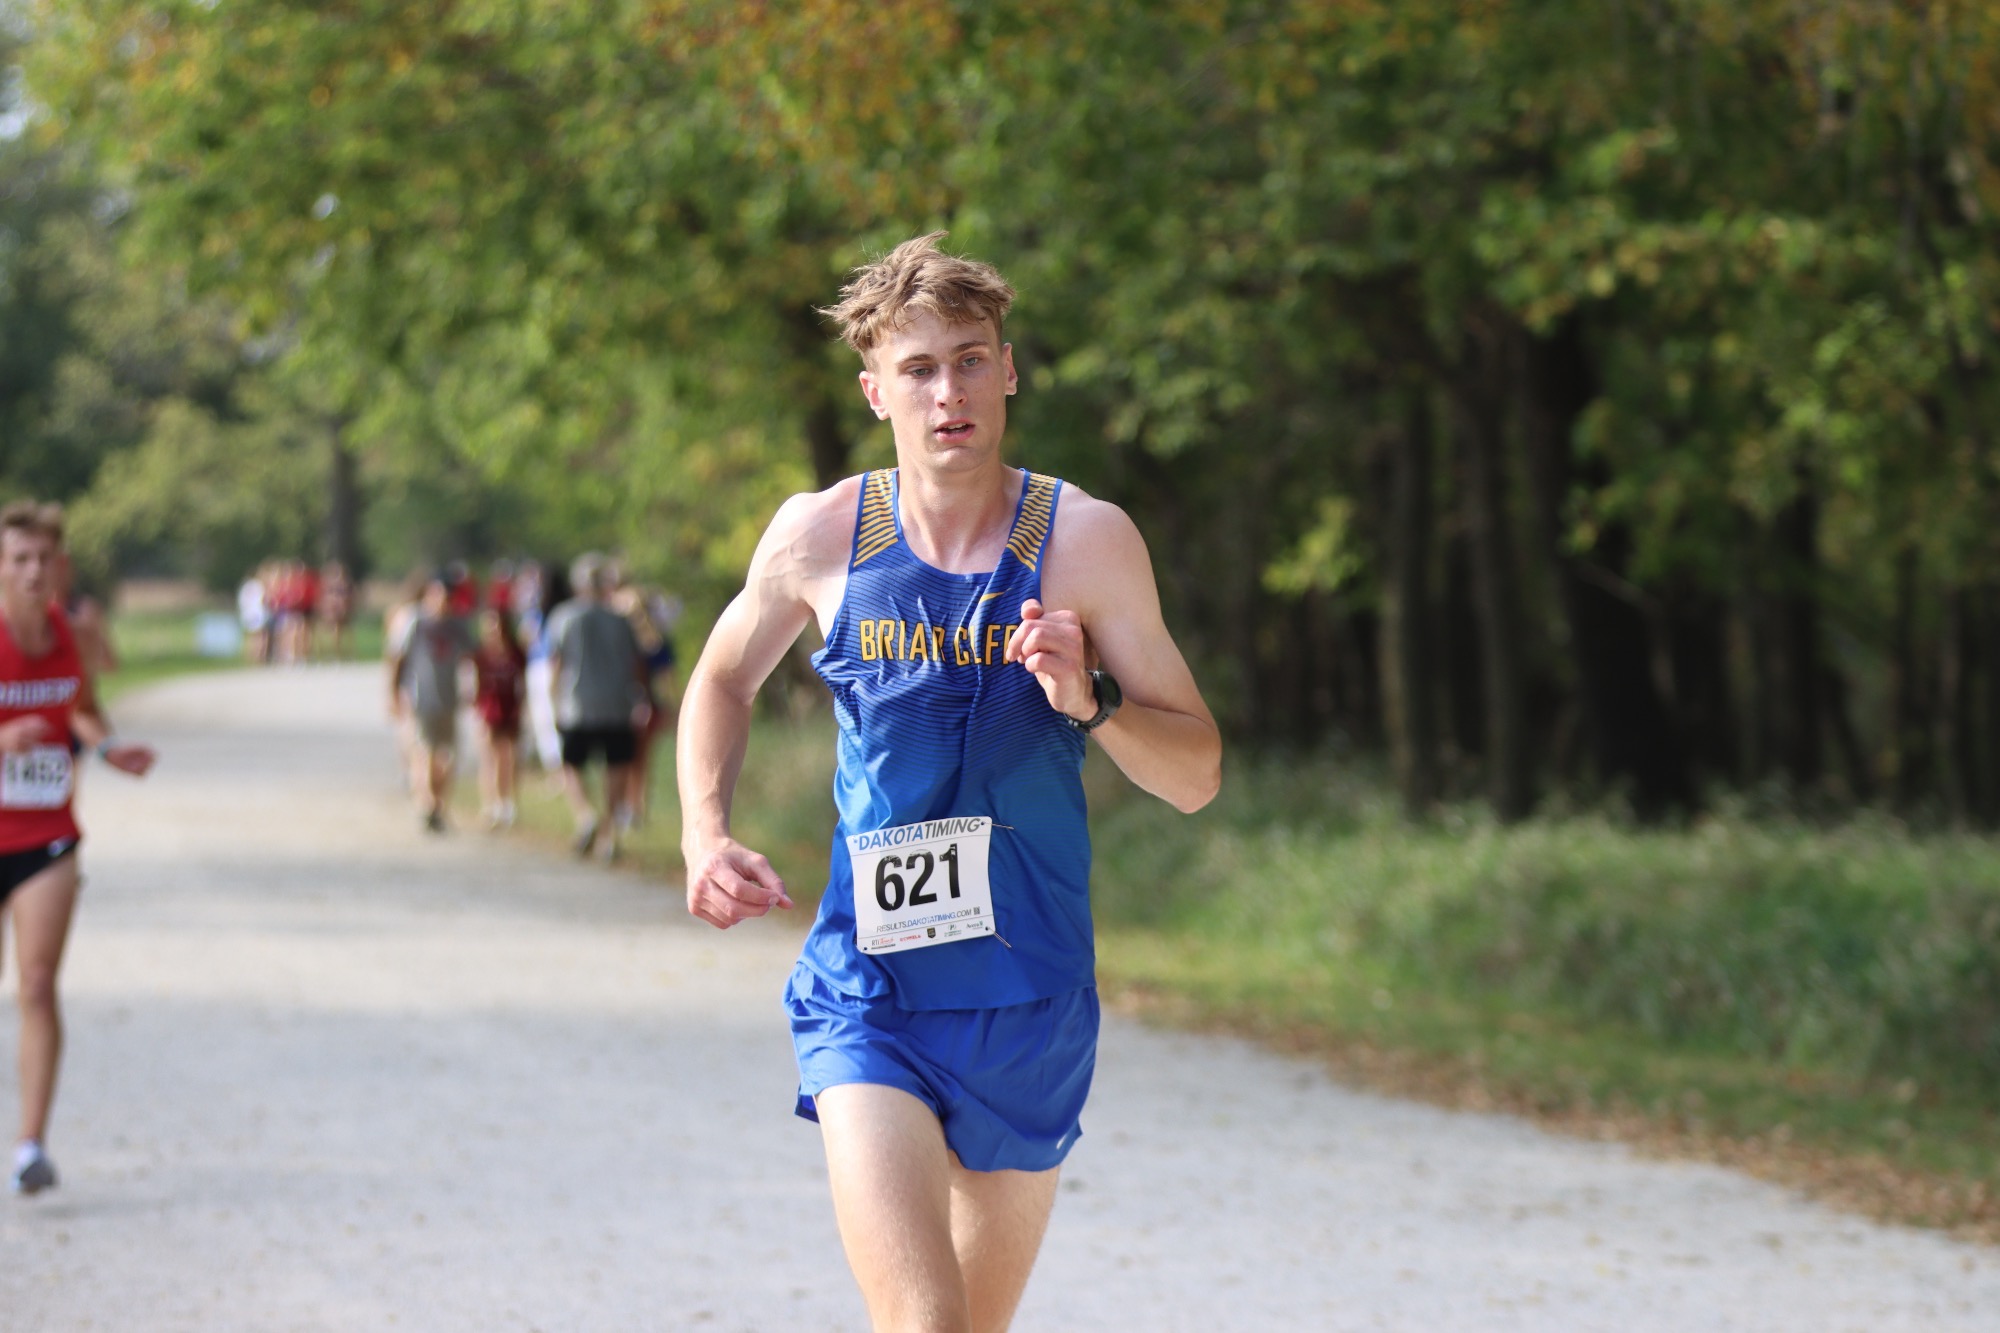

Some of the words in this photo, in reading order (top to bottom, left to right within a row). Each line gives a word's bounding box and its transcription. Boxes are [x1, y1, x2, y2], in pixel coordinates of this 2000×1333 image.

[859, 618, 946, 662] BRIAR
[859, 818, 981, 850] DAKOTATIMING
[875, 843, 961, 911] 621
